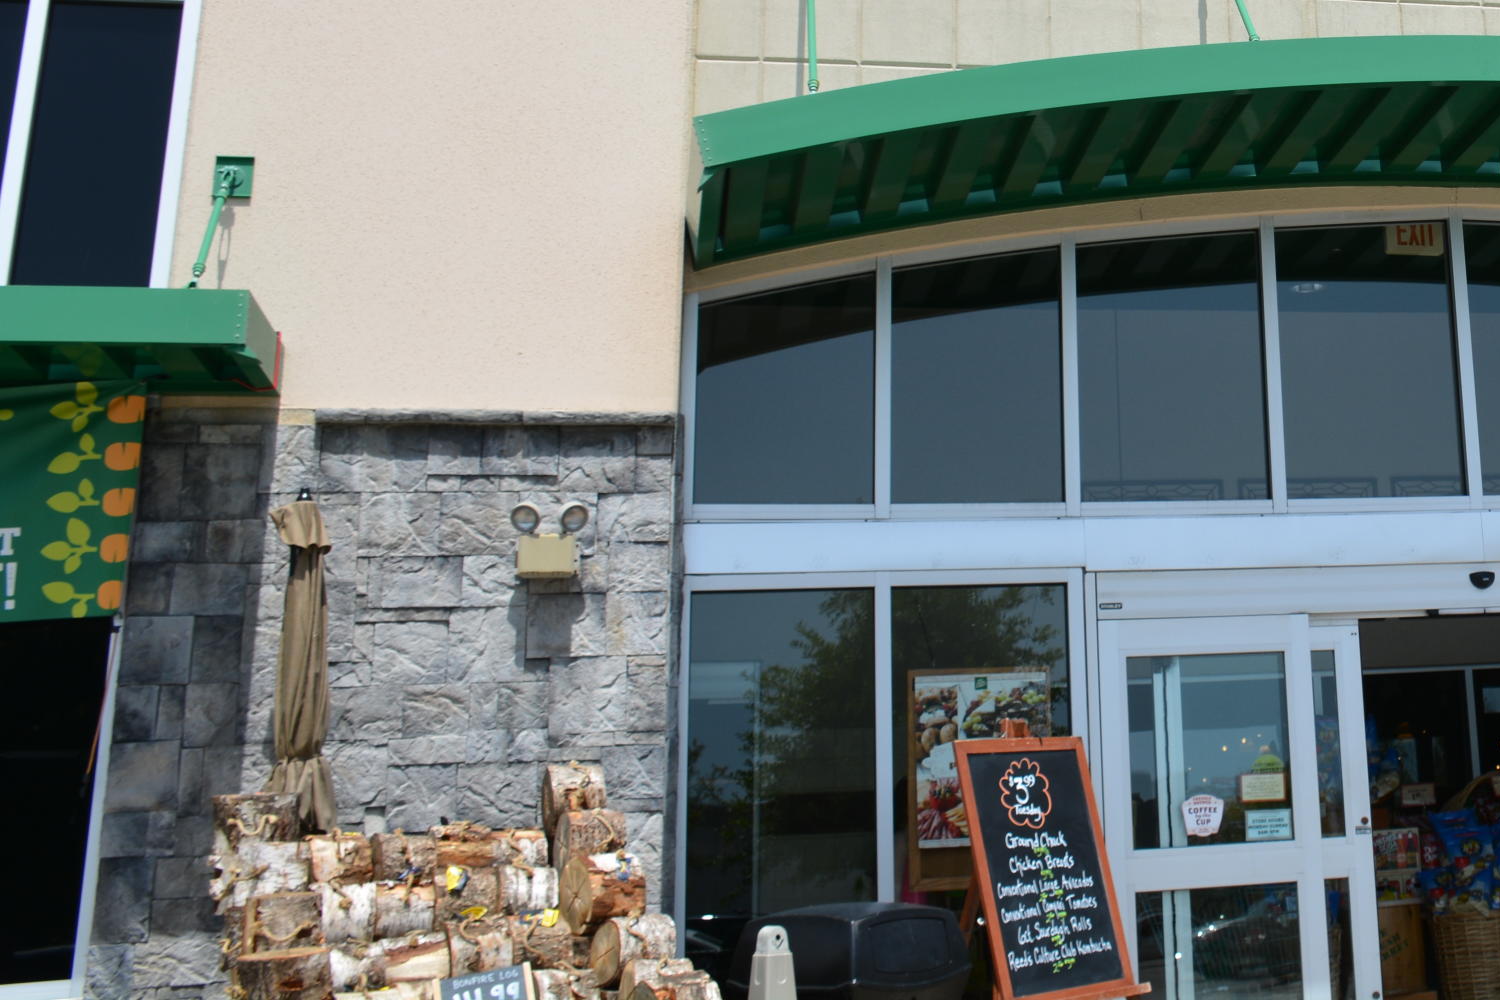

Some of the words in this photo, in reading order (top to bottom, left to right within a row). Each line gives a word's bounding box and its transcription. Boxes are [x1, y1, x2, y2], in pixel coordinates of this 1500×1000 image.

[1013, 803, 1042, 822] Tuesday
[1188, 806, 1218, 815] COFFEE
[1195, 818, 1212, 826] CUP
[1005, 832, 1040, 849] Ground
[1040, 830, 1068, 848] Chuck
[1009, 855, 1044, 877] Chicken
[452, 973, 495, 990] BONFIRE
